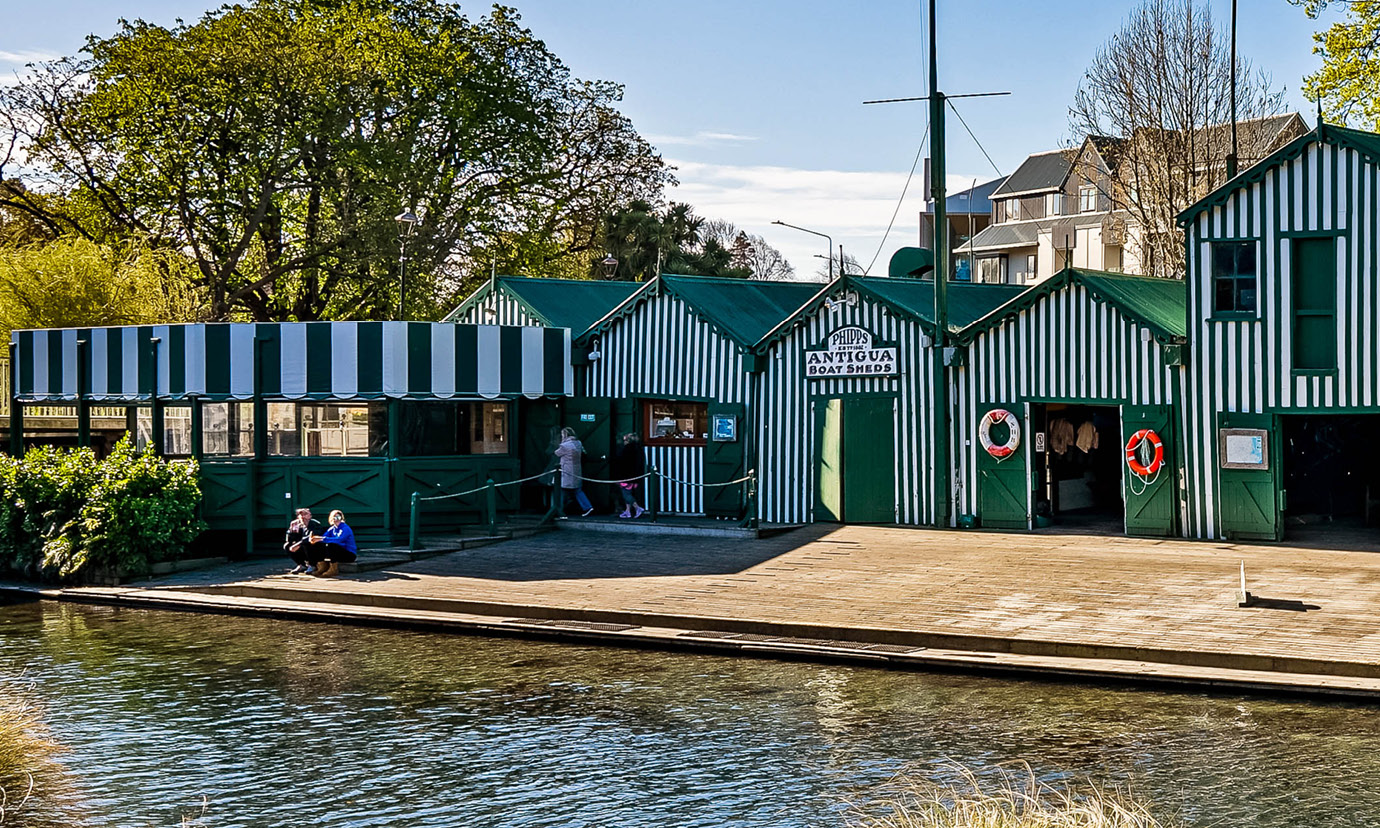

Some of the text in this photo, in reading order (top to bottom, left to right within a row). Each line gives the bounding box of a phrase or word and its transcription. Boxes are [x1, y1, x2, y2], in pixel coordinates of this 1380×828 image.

[832, 328, 869, 346] PHIPPS
[807, 349, 894, 365] ANTIGUA
[808, 363, 893, 376] BOAT SHEDS
